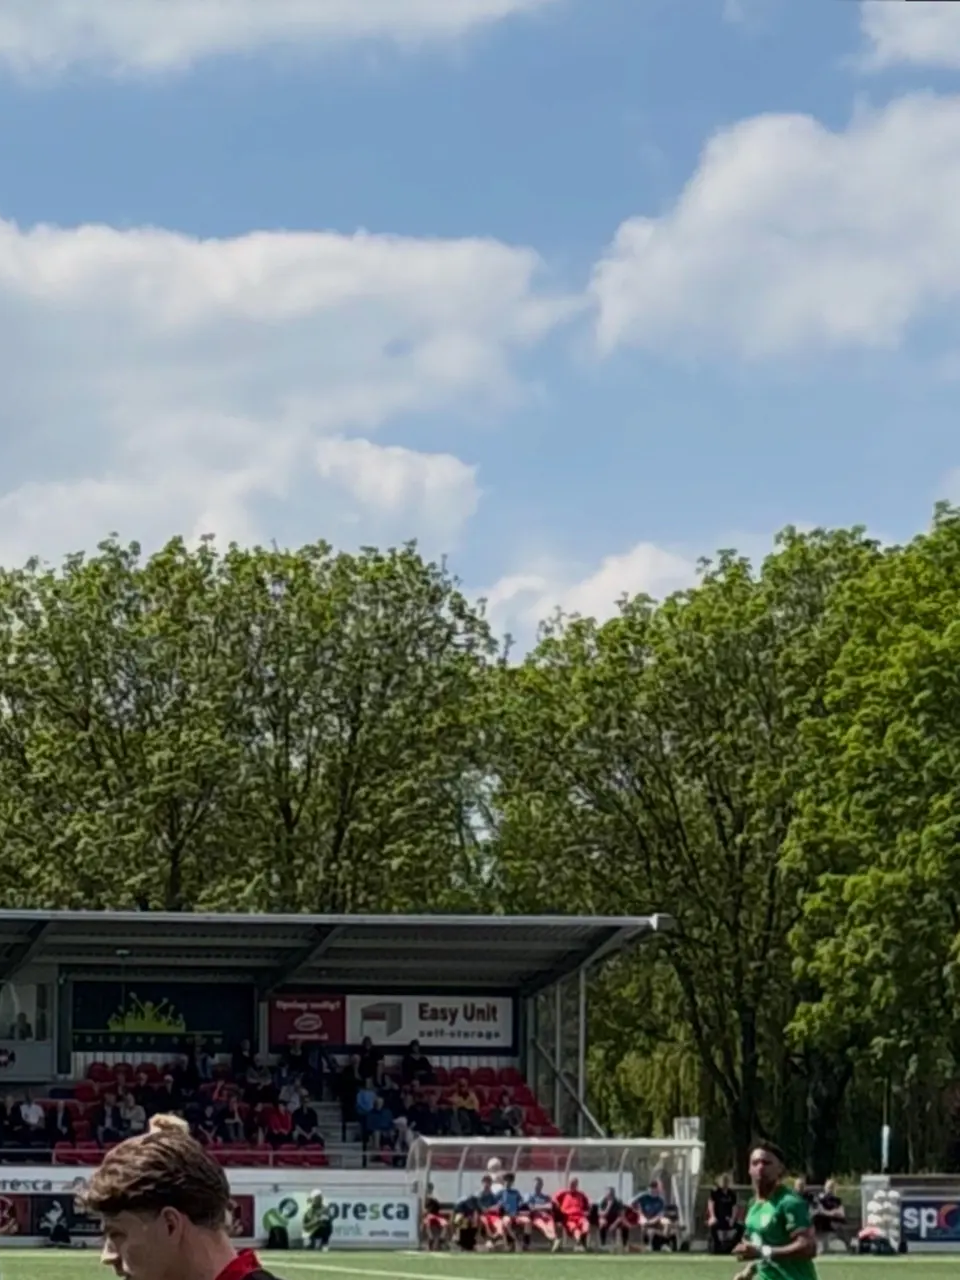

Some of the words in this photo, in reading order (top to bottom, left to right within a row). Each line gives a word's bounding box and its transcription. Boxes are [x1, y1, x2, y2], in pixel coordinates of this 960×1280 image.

[418, 1003, 458, 1026] Easy
[463, 1002, 497, 1021] Unit
[329, 1202, 410, 1220] oresca
